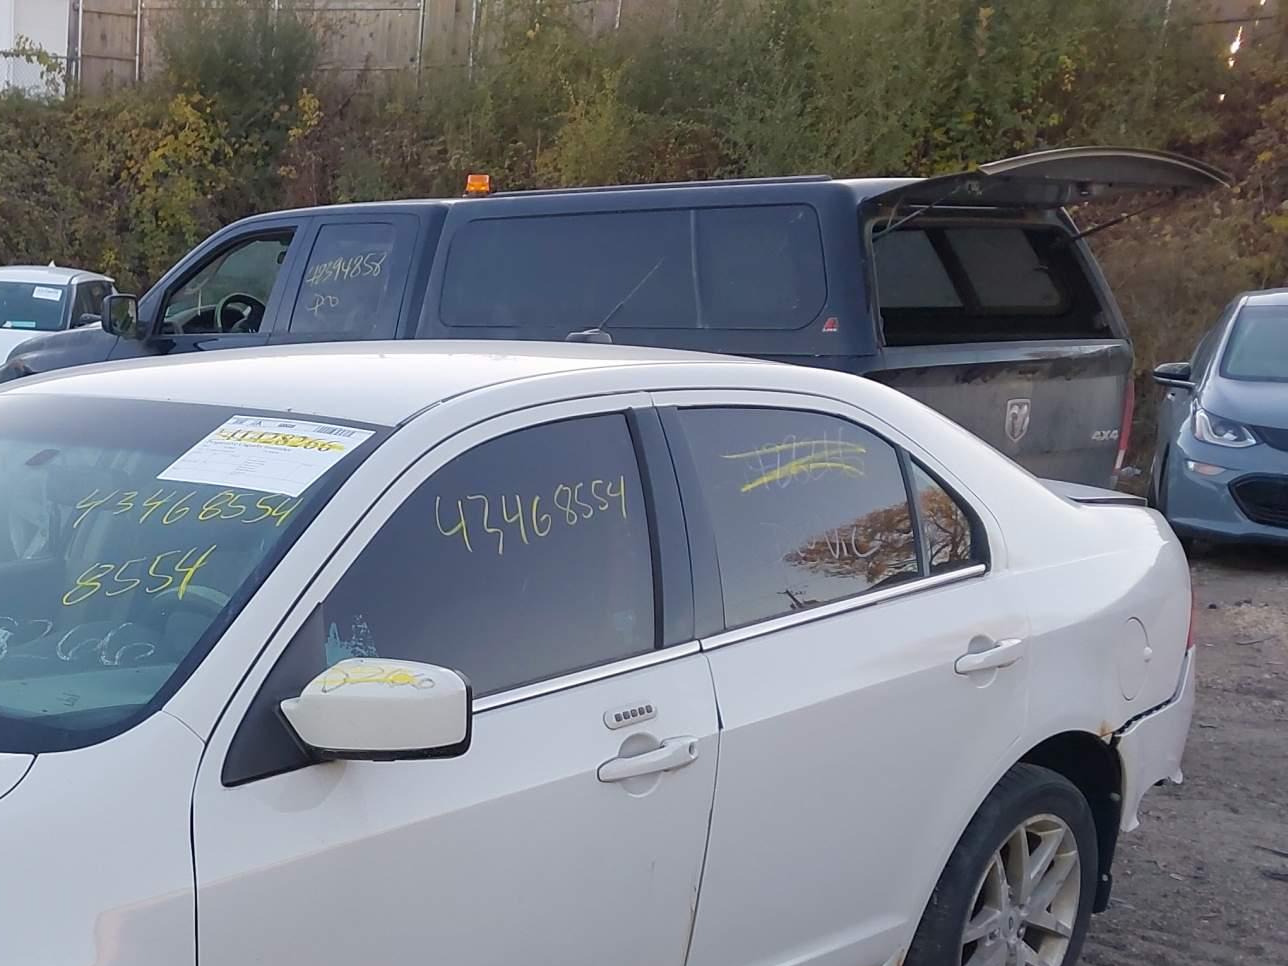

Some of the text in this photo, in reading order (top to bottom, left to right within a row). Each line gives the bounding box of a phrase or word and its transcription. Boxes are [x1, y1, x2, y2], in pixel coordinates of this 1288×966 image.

[72, 488, 304, 528] 43468554
[435, 475, 627, 555] 43468554
[62, 544, 217, 606] 8554
